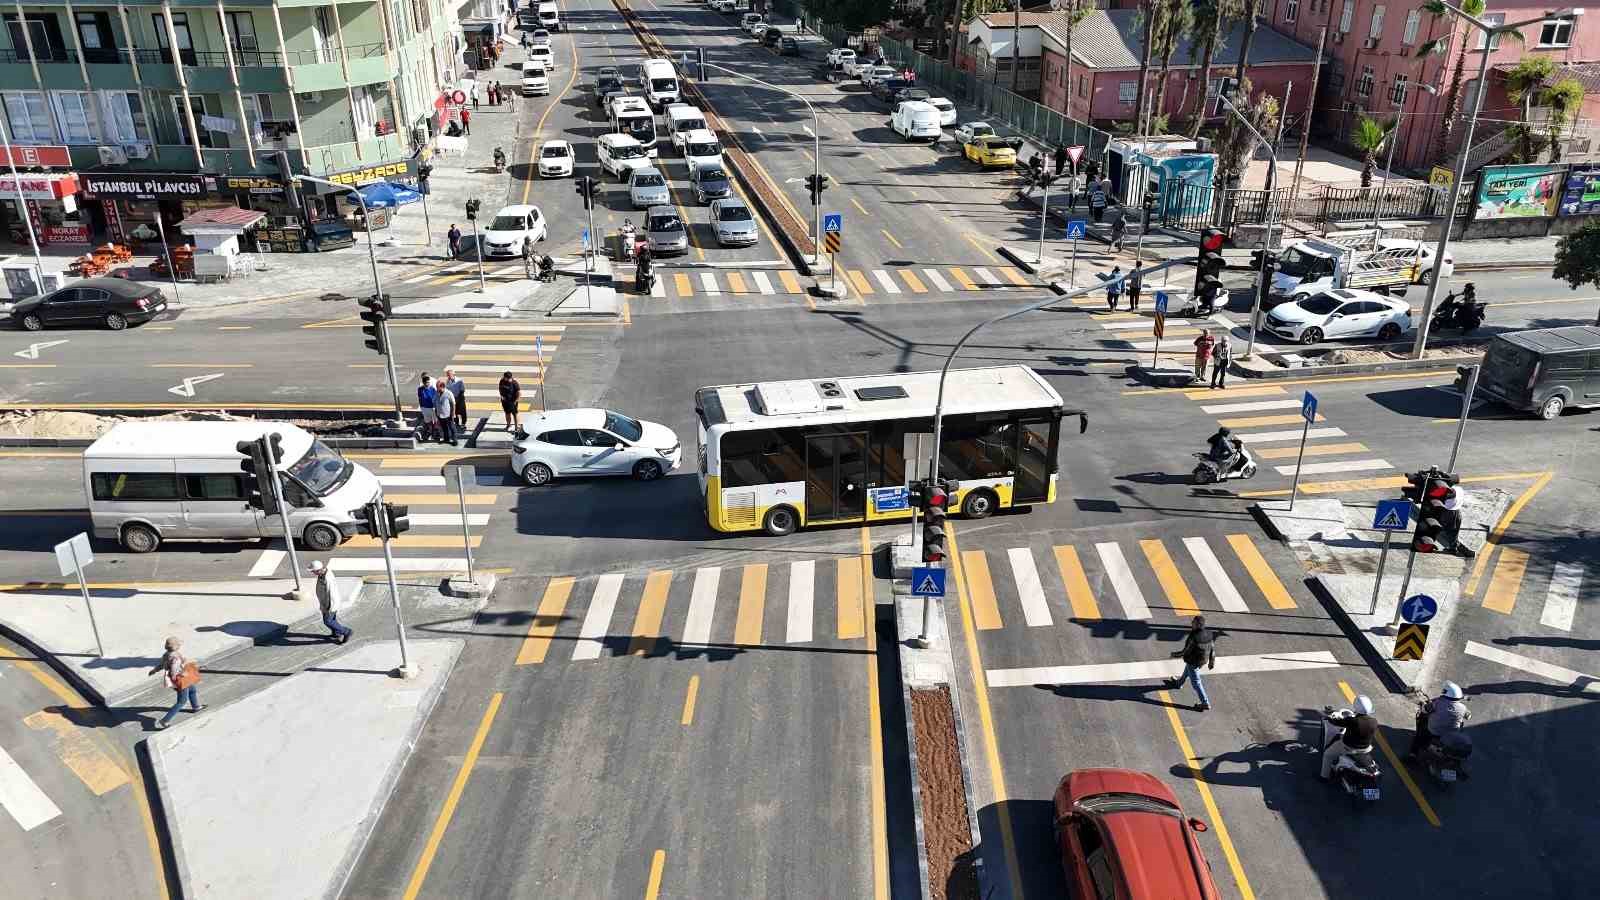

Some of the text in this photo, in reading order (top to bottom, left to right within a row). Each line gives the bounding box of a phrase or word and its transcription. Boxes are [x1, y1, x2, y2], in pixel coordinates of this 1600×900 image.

[25, 149, 36, 162] E
[87, 179, 142, 193] İSTANBUL
[227, 178, 303, 189] BEYZAE
